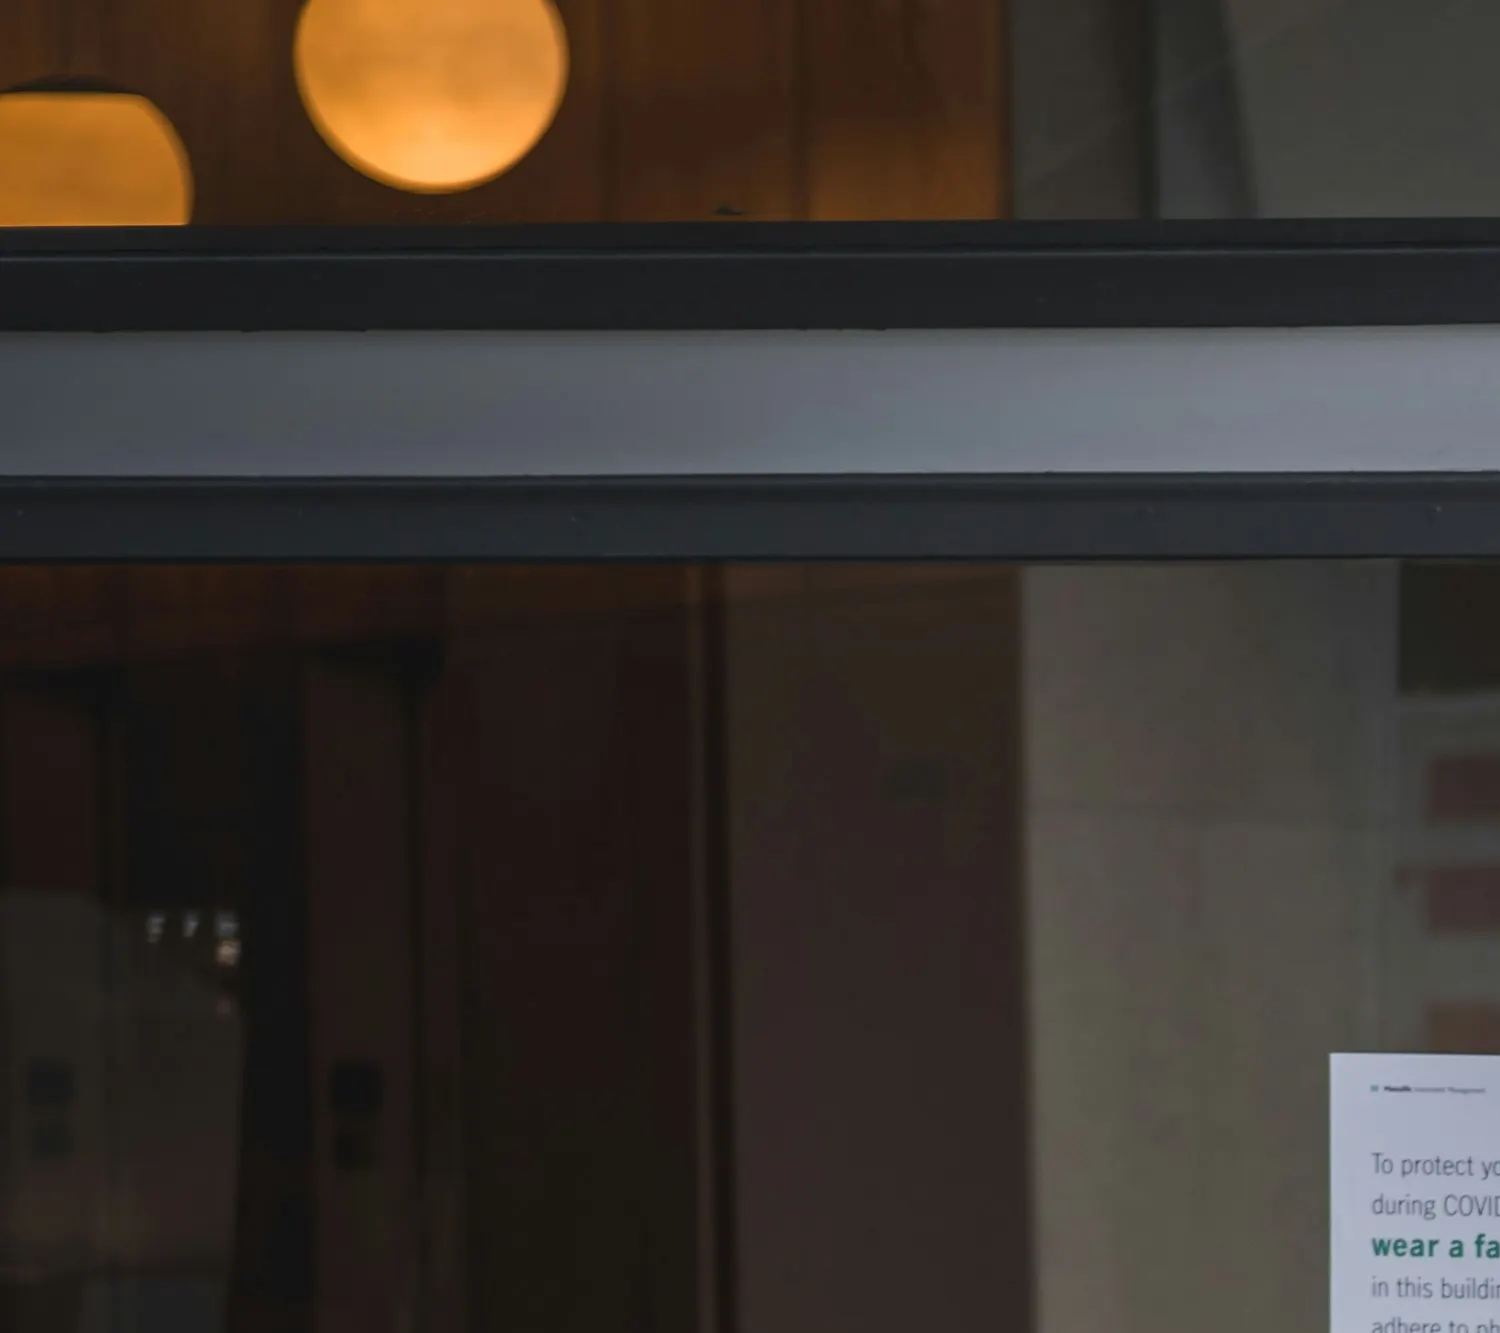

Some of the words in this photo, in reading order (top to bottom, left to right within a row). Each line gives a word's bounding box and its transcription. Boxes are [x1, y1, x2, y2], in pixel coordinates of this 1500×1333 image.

[1371, 1152, 1393, 1174] To
[1401, 1156, 1474, 1177] protect
[1372, 1194, 1436, 1221] during
[1372, 1238, 1440, 1257] wear
[1449, 1240, 1464, 1258] a
[1372, 1276, 1389, 1297] in
[1396, 1277, 1433, 1299] this
